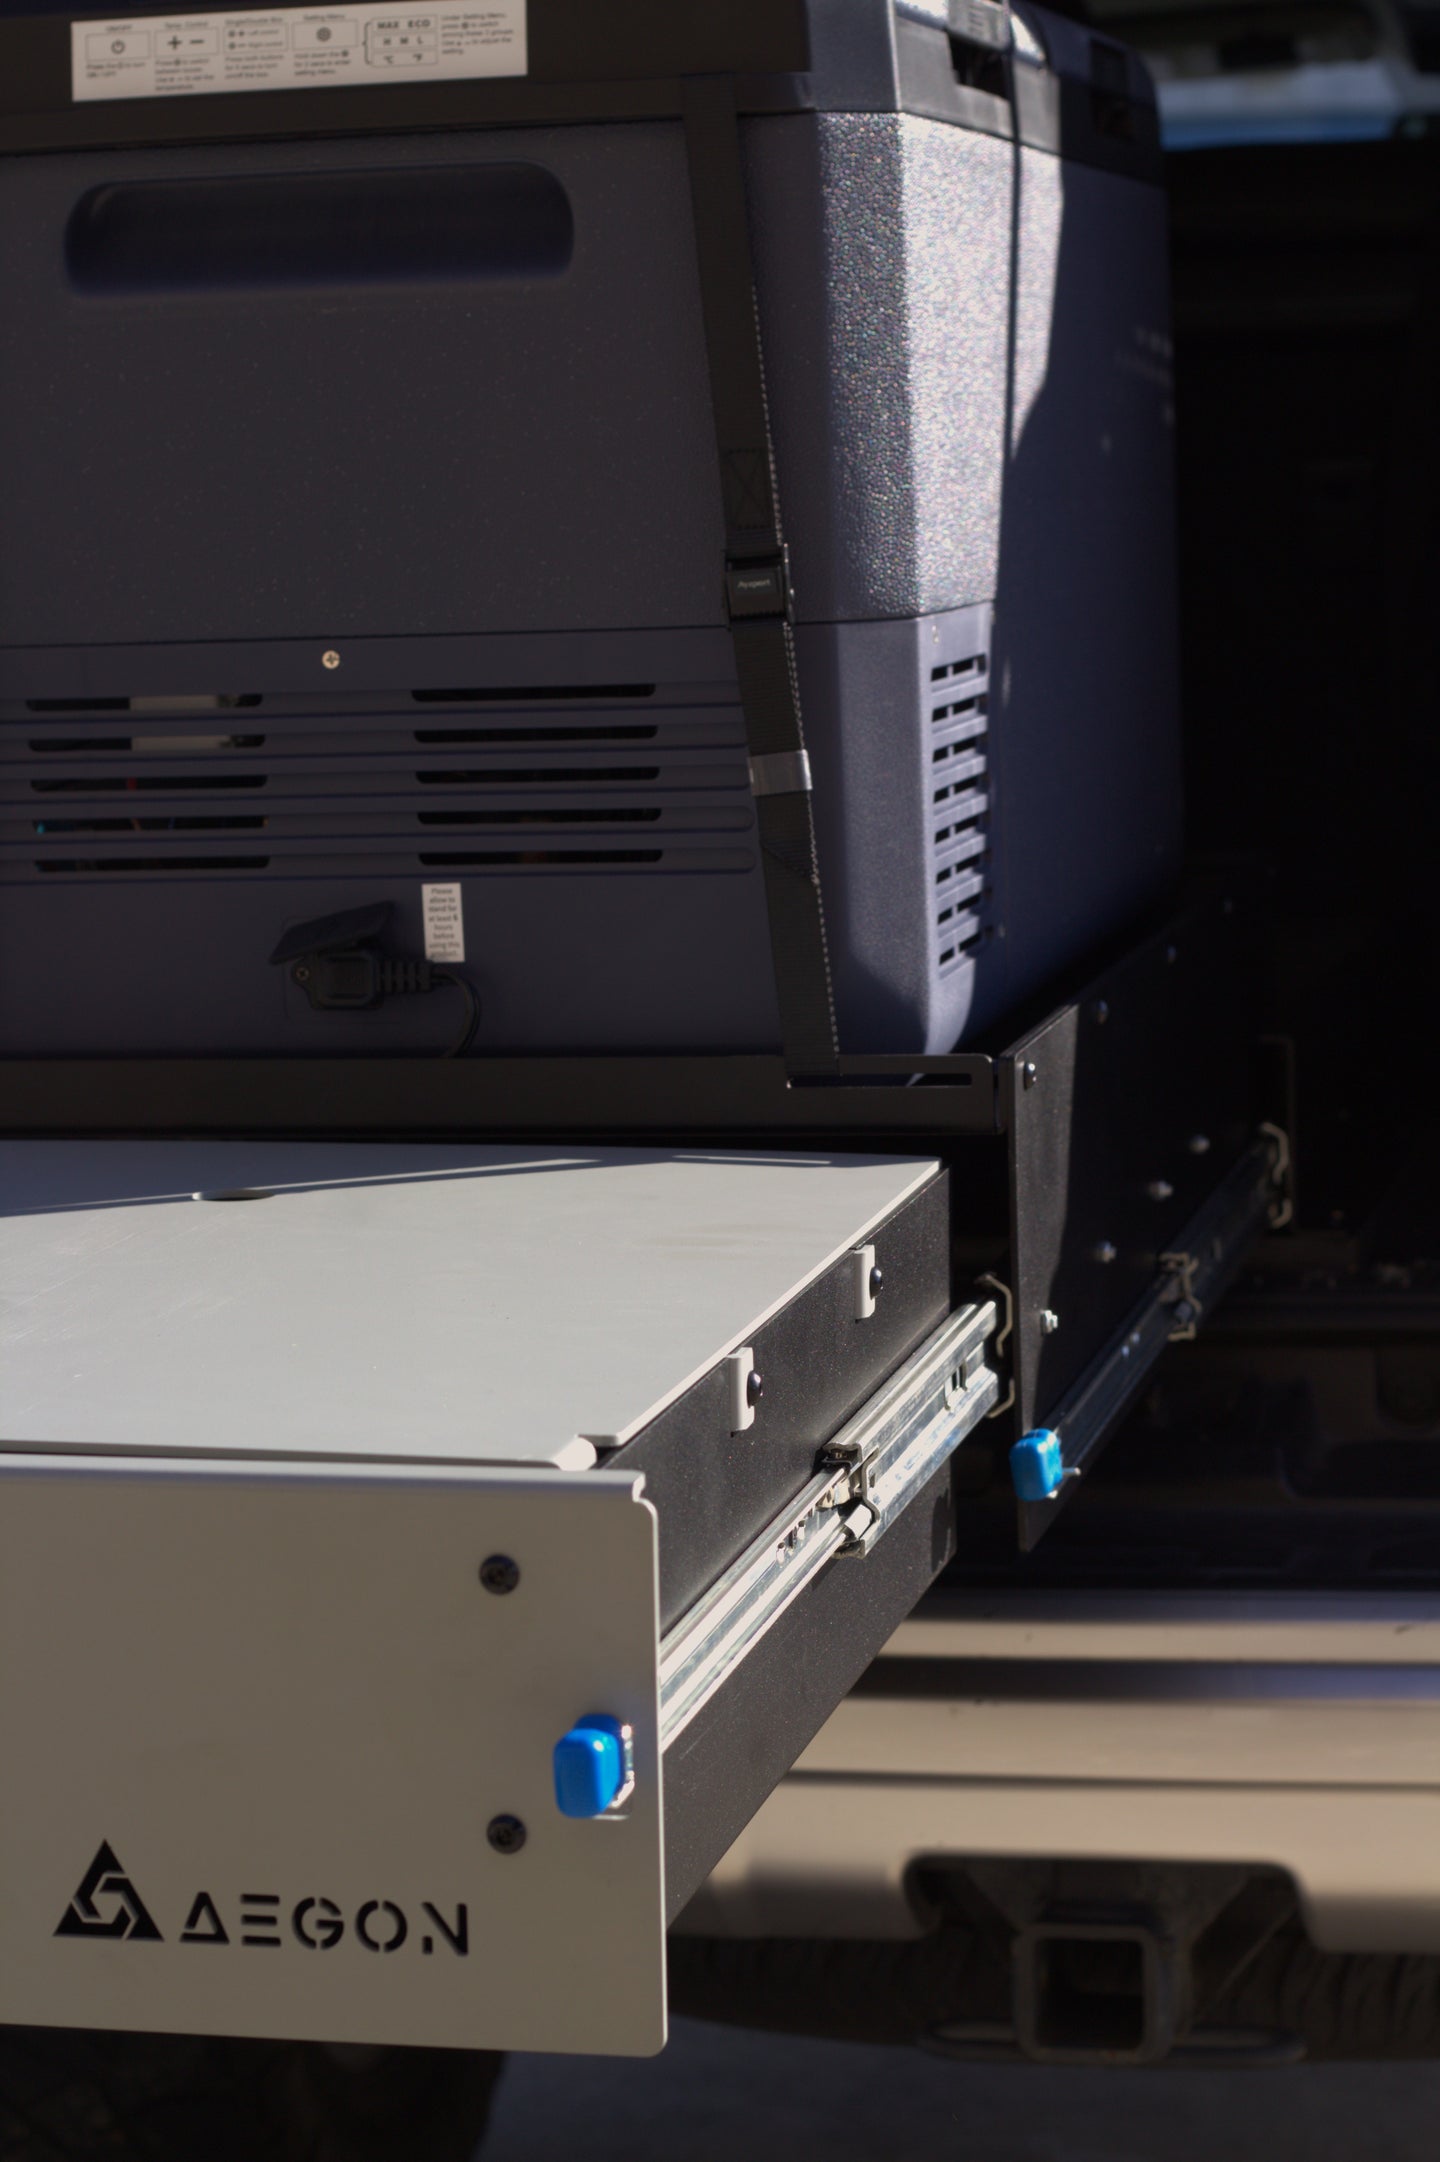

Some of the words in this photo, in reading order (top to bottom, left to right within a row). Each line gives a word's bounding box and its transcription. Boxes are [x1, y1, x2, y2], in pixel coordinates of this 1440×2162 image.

[377, 21, 399, 29] MAX
[407, 19, 430, 28] ECO
[178, 1891, 470, 1957] AEGON
